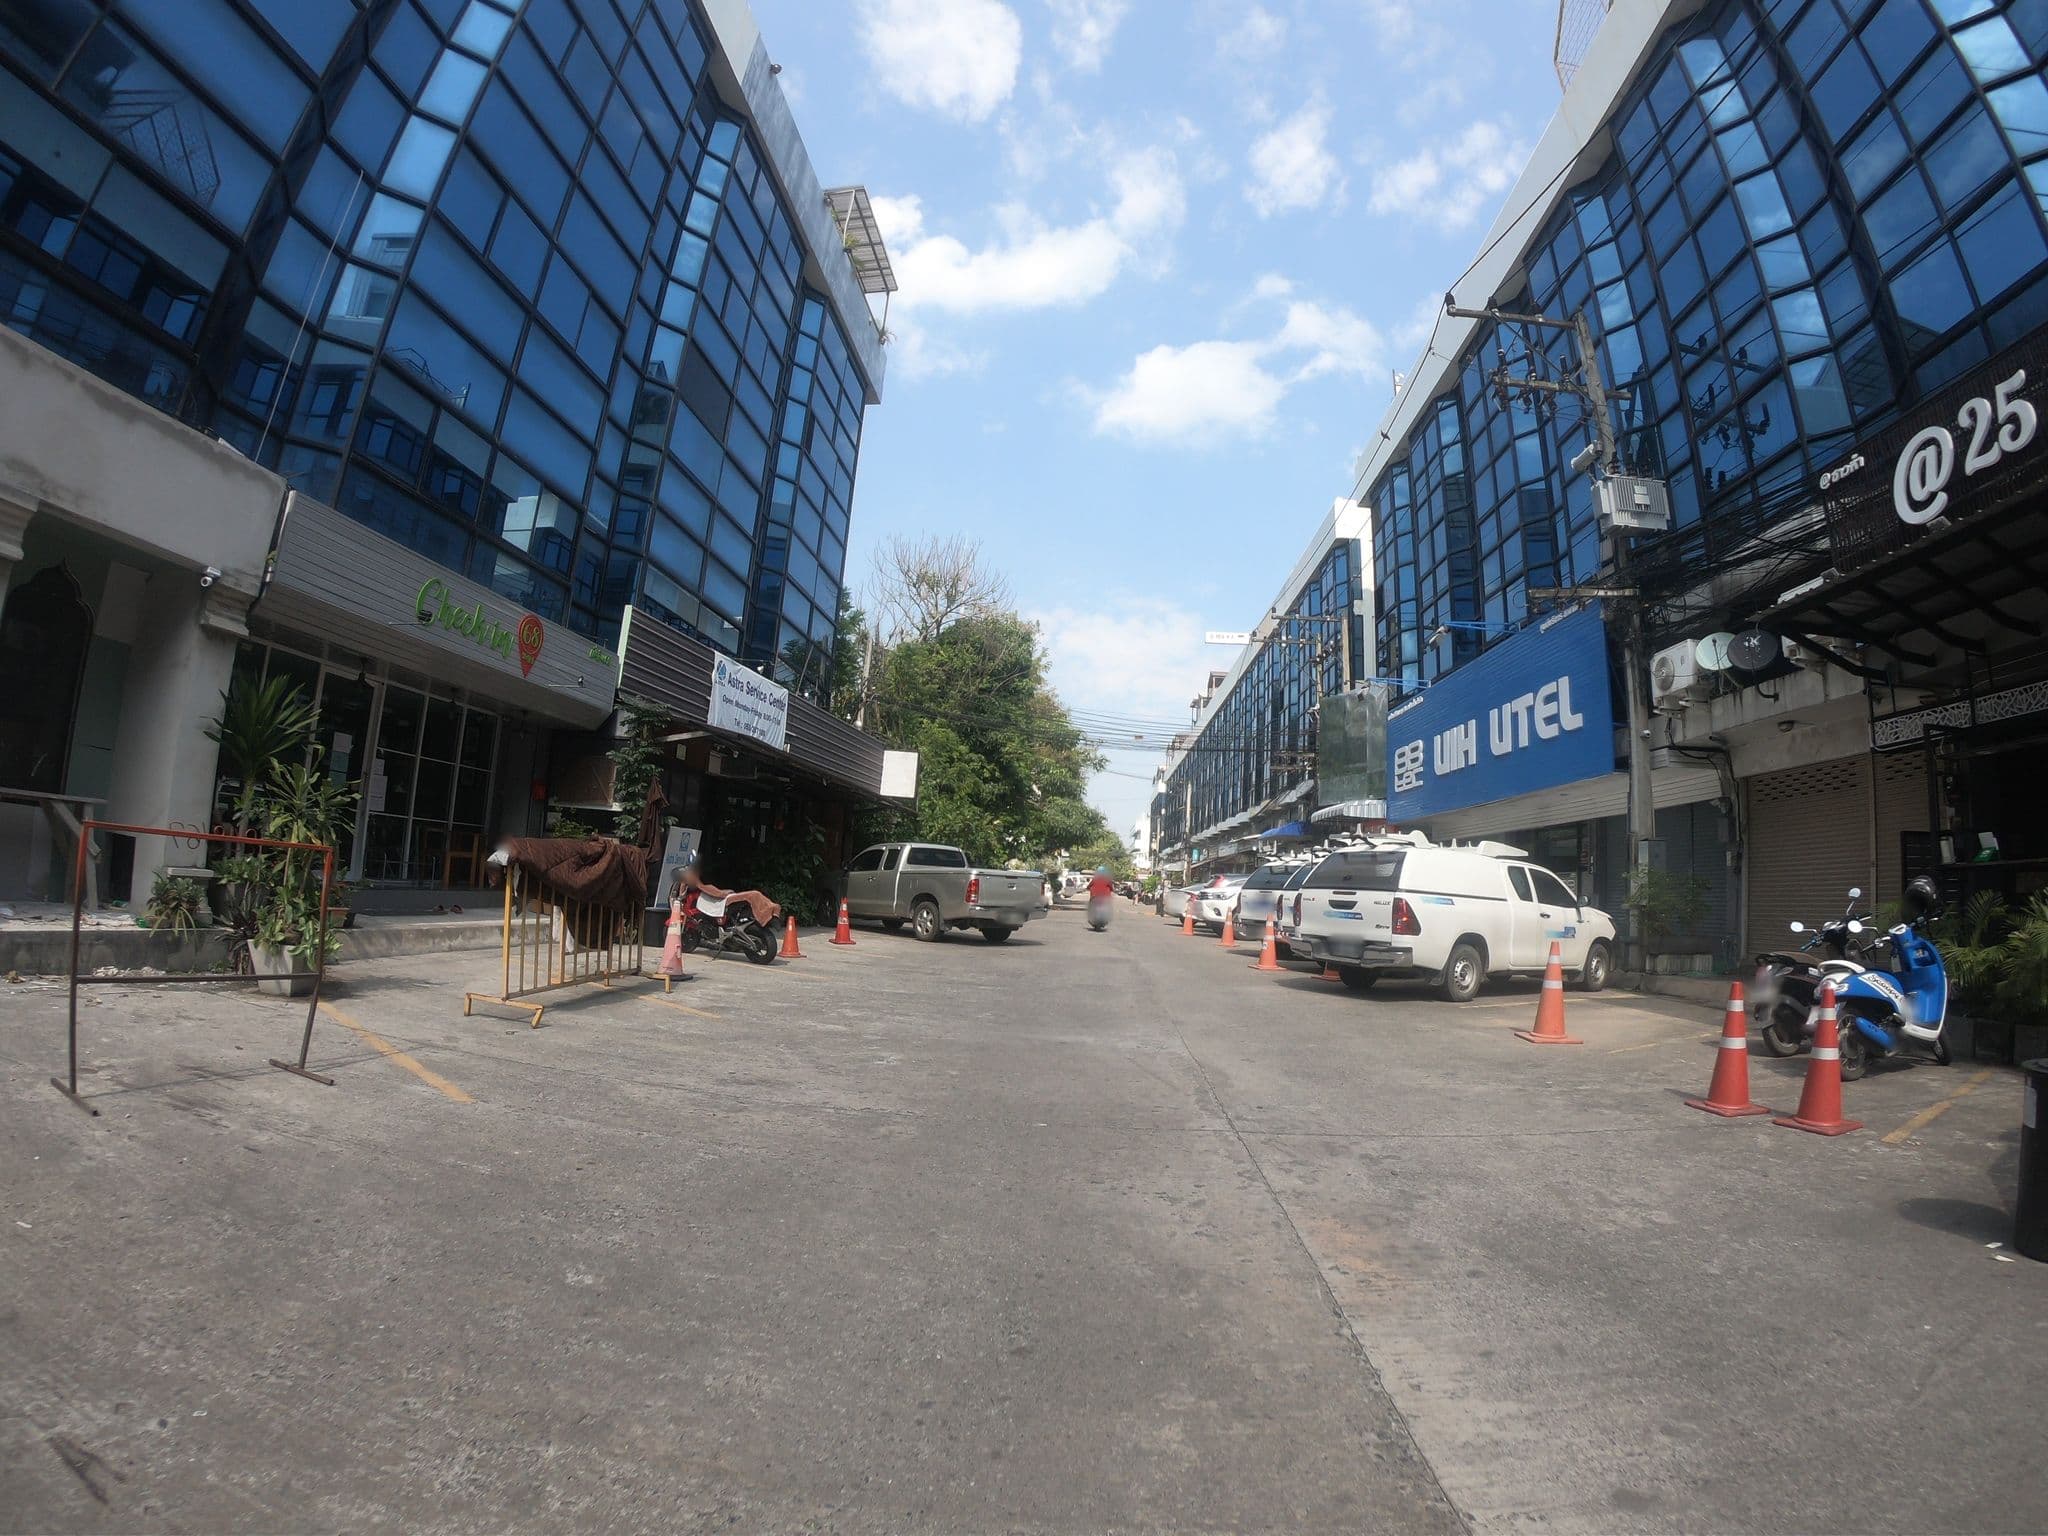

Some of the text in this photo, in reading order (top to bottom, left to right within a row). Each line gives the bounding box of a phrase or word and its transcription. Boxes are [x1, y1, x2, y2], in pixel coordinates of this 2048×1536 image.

[522, 624, 541, 647] 68
[722, 694, 734, 705] Open
[728, 672, 786, 712] Astra Service Center
[1433, 675, 1584, 776] UIH UTEL
